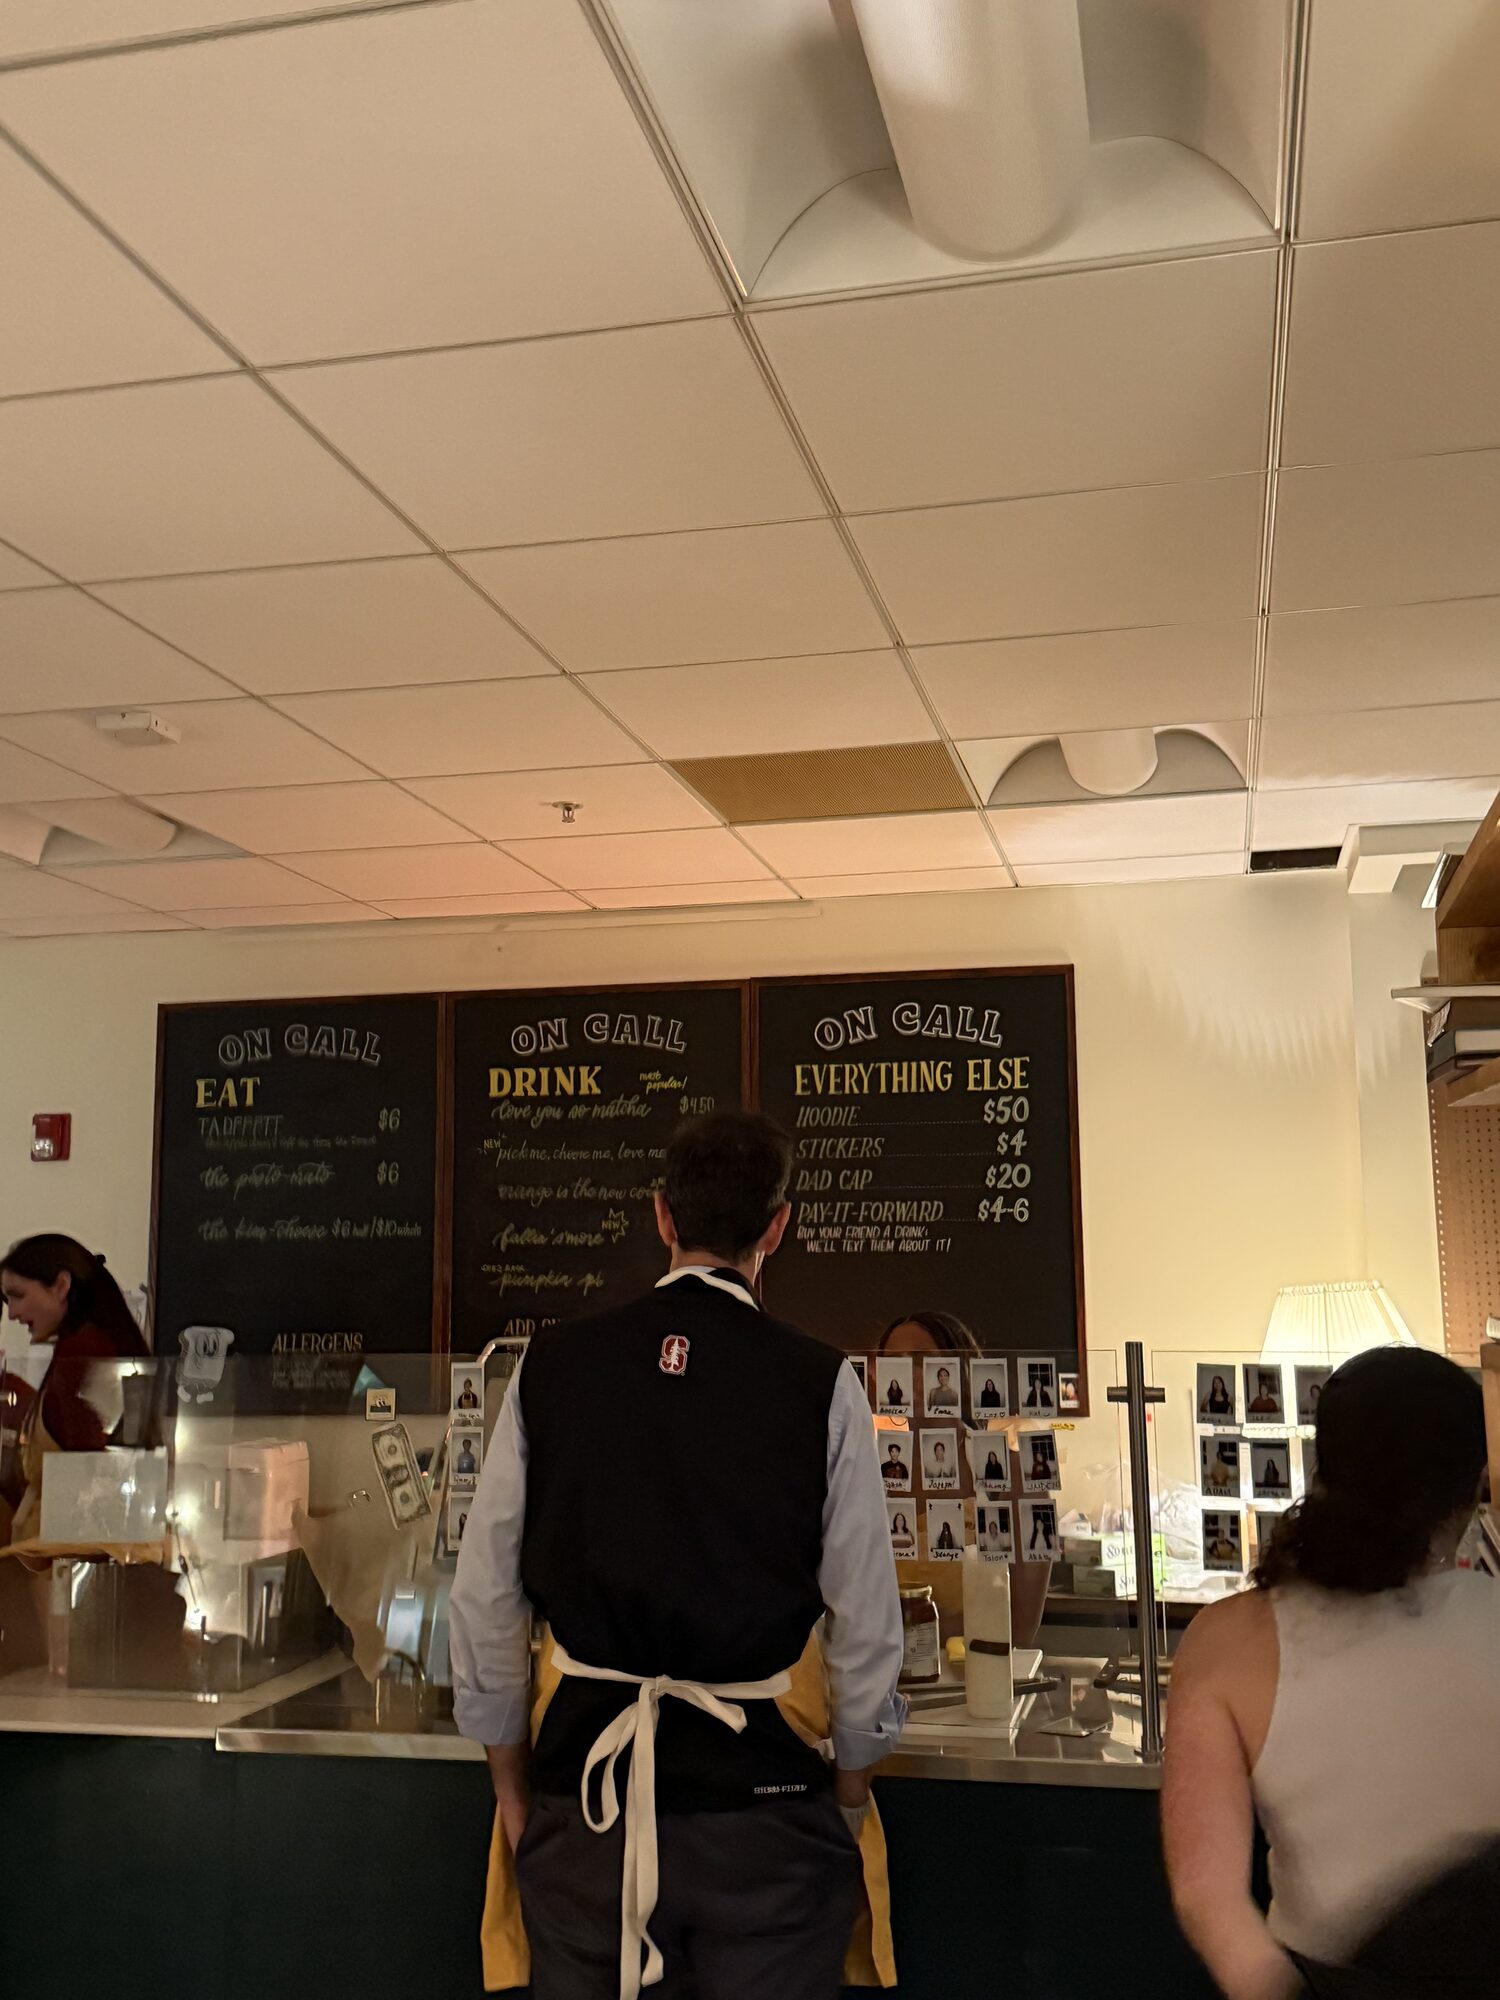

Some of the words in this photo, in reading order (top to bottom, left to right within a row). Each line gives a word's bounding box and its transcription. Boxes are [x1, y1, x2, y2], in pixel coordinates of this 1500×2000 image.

[511, 1017, 569, 1056] ON
[584, 1013, 687, 1054] CALL
[814, 1005, 878, 1051] ON
[893, 1002, 1002, 1048] CALL
[218, 1028, 272, 1066] ON
[284, 1024, 382, 1067] CALL
[489, 1065, 602, 1098] DRINK
[794, 1061, 953, 1096] EVERYTHING
[966, 1056, 1030, 1091] ELSE
[196, 1076, 261, 1109] EAT
[379, 1107, 402, 1132] $6
[529, 1106, 564, 1130] you
[591, 1094, 653, 1121] matcha
[795, 1105, 861, 1128] HOODIE
[983, 1095, 1030, 1125] $50
[617, 1141, 646, 1161] love
[796, 1137, 886, 1159] STICKERS
[996, 1128, 1028, 1157] $4
[376, 1160, 400, 1186] $6
[796, 1168, 833, 1192] DAD
[838, 1168, 873, 1190] CAP
[985, 1165, 1032, 1190] $20
[797, 1200, 946, 1226] PAY-IT-FORWARD
[977, 1196, 1031, 1223] $4-6
[818, 1226, 843, 1239] YOUR
[845, 1224, 881, 1239] FRIEND
[883, 1224, 891, 1238] A
[841, 1239, 866, 1253] TEXT
[869, 1239, 895, 1252] THEM
[898, 1238, 931, 1252] ABOUT
[504, 1318, 537, 1336] ADD
[271, 1332, 364, 1353] ALLERGENS
